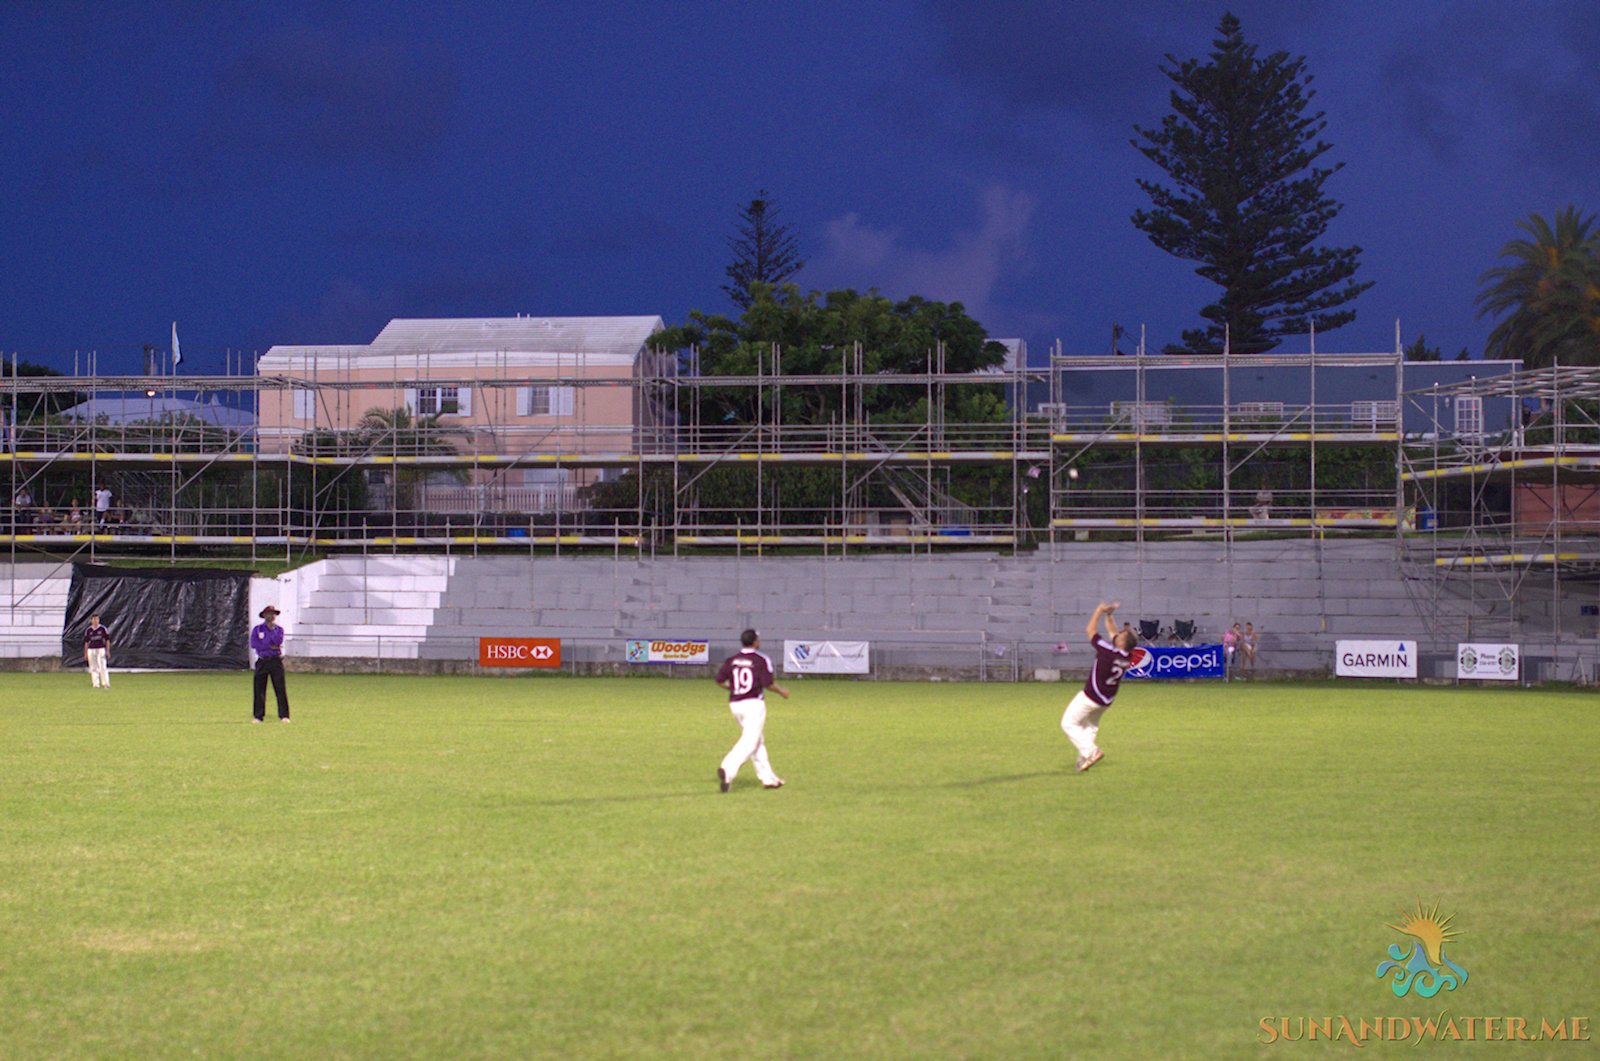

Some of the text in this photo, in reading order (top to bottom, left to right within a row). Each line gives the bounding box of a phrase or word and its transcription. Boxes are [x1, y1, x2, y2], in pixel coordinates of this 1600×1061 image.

[487, 645, 528, 659] HSBC
[651, 641, 706, 656] Woodys
[1156, 650, 1217, 672] pepsi
[1342, 653, 1408, 668] GARMIN
[732, 667, 754, 695] 19
